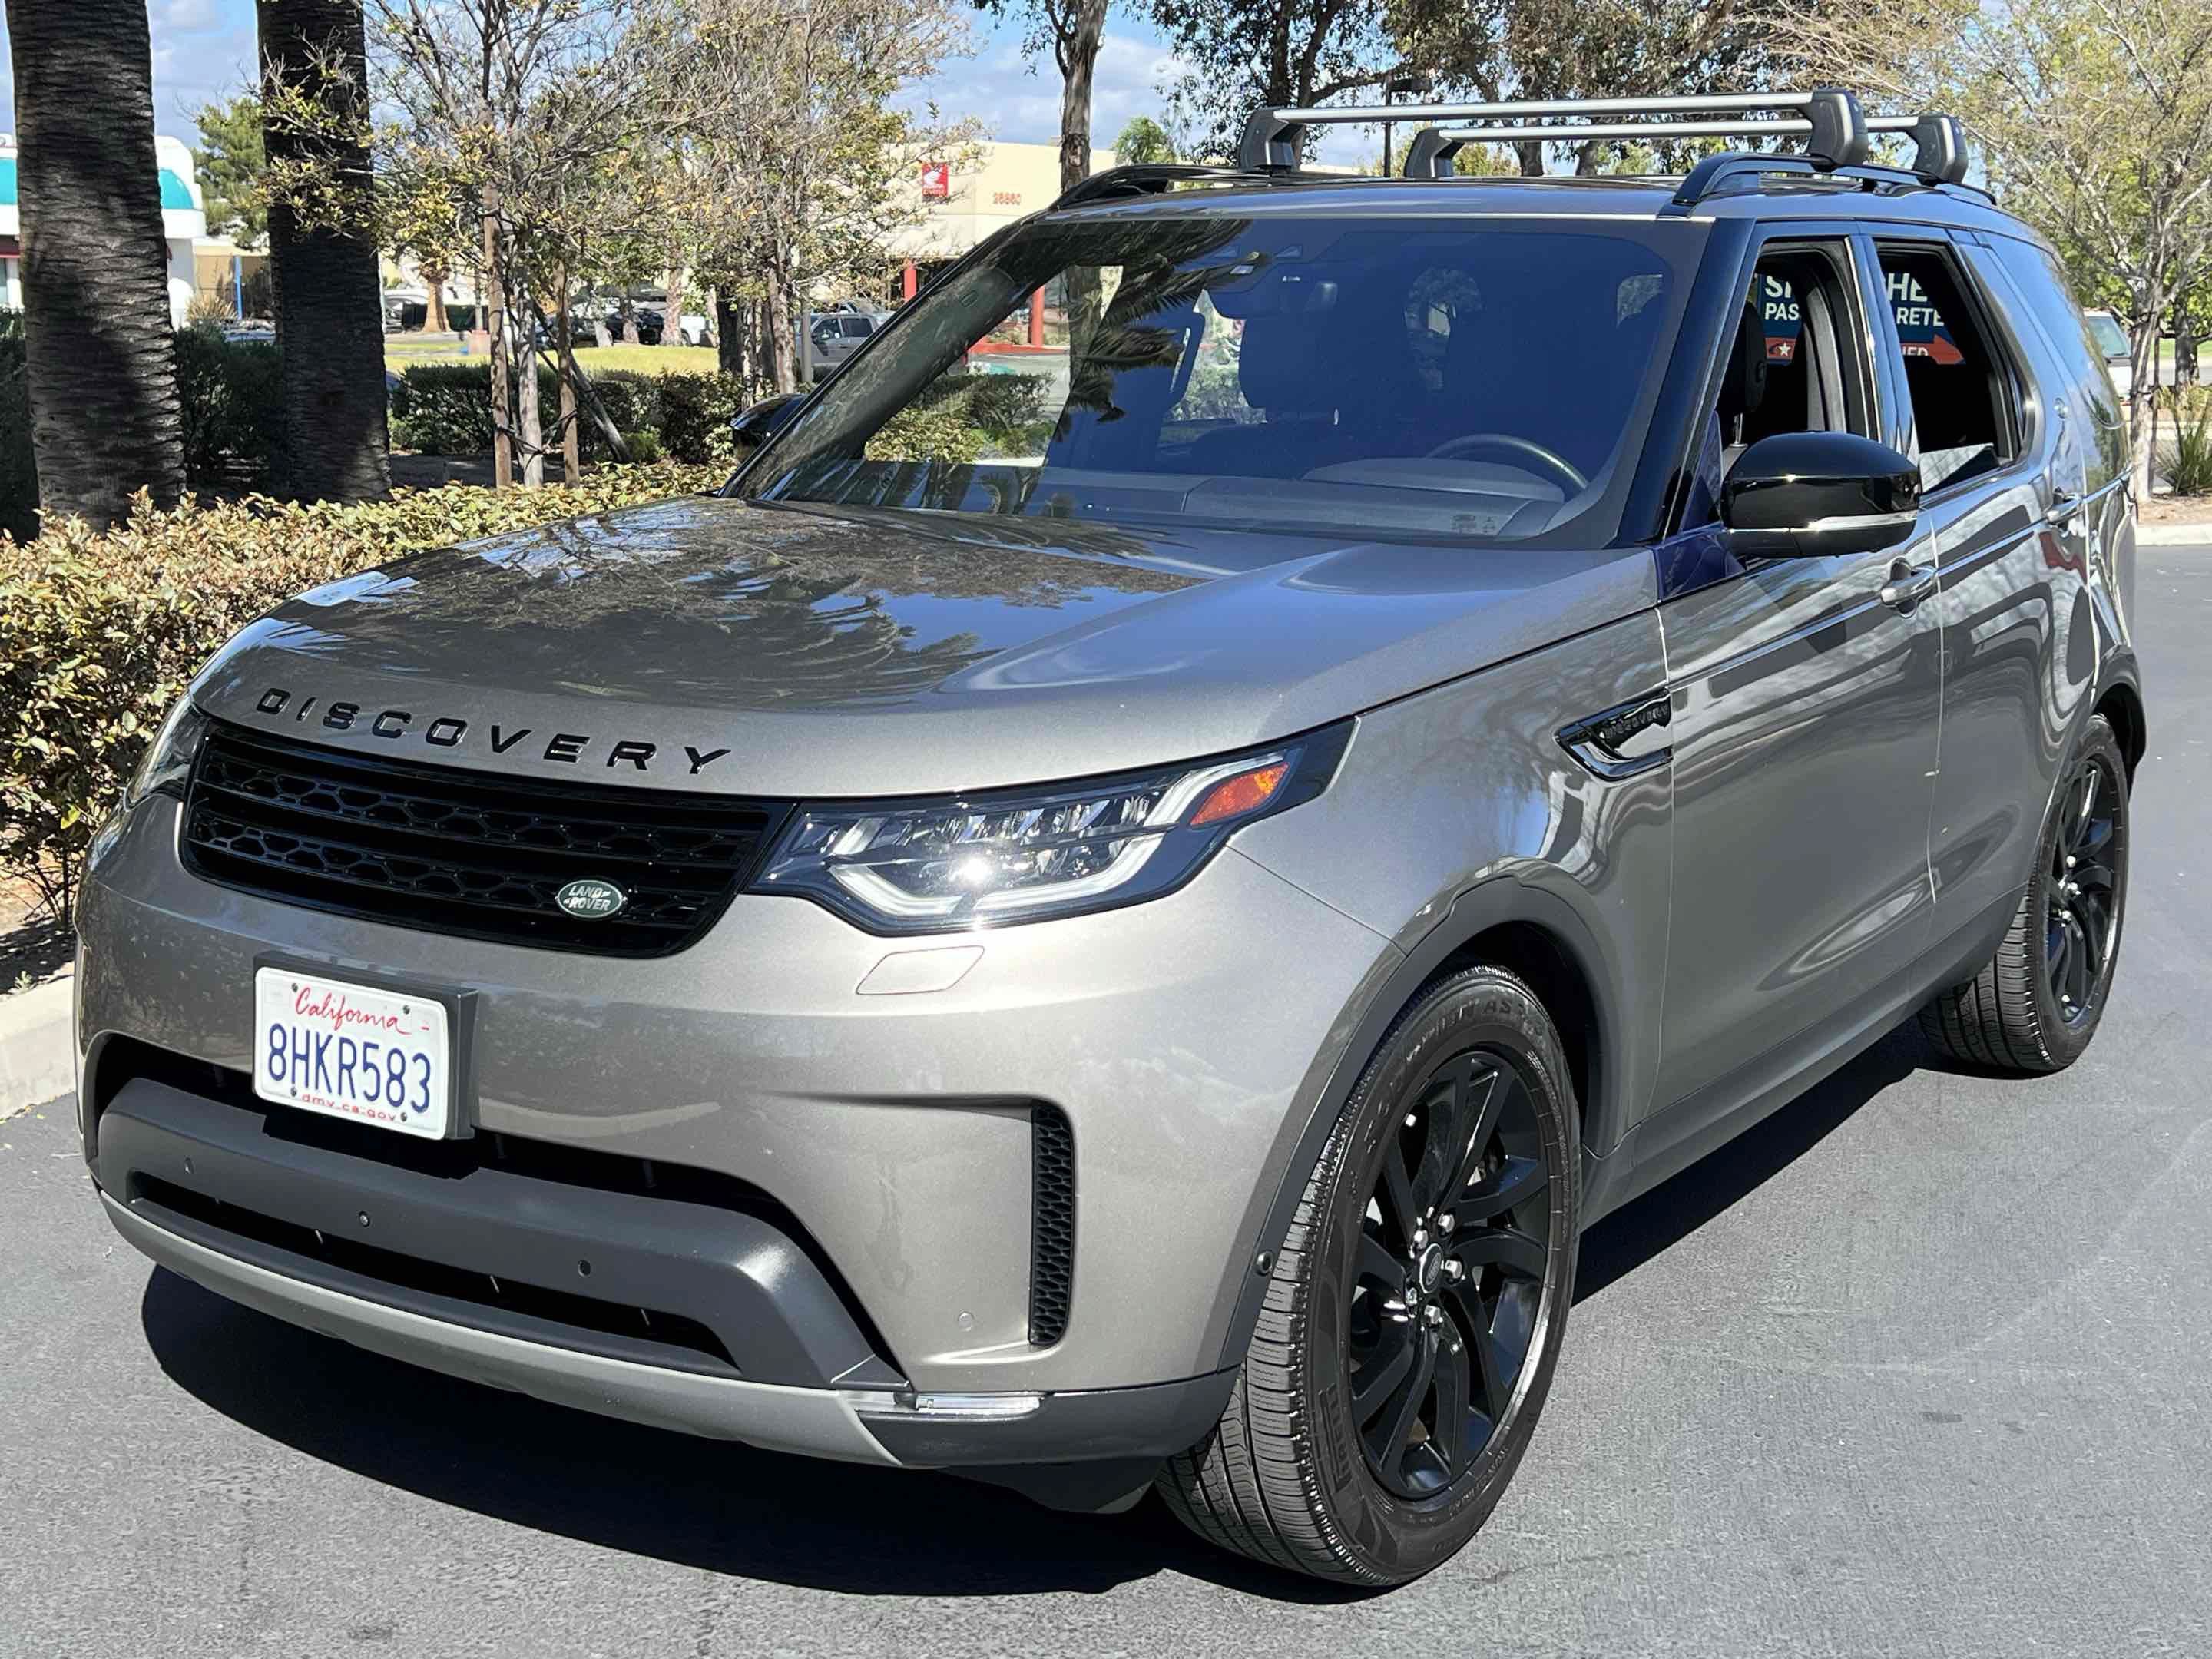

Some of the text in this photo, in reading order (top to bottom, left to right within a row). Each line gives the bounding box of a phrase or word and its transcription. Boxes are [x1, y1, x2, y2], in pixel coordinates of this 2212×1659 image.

[257, 688, 731, 774] DISCOVERY
[569, 885, 603, 898] LAND
[569, 897, 611, 911] ROVER
[295, 987, 412, 1035] California
[269, 1023, 431, 1114] 8HKR583
[301, 1093, 397, 1122] dmv.ca.gov
